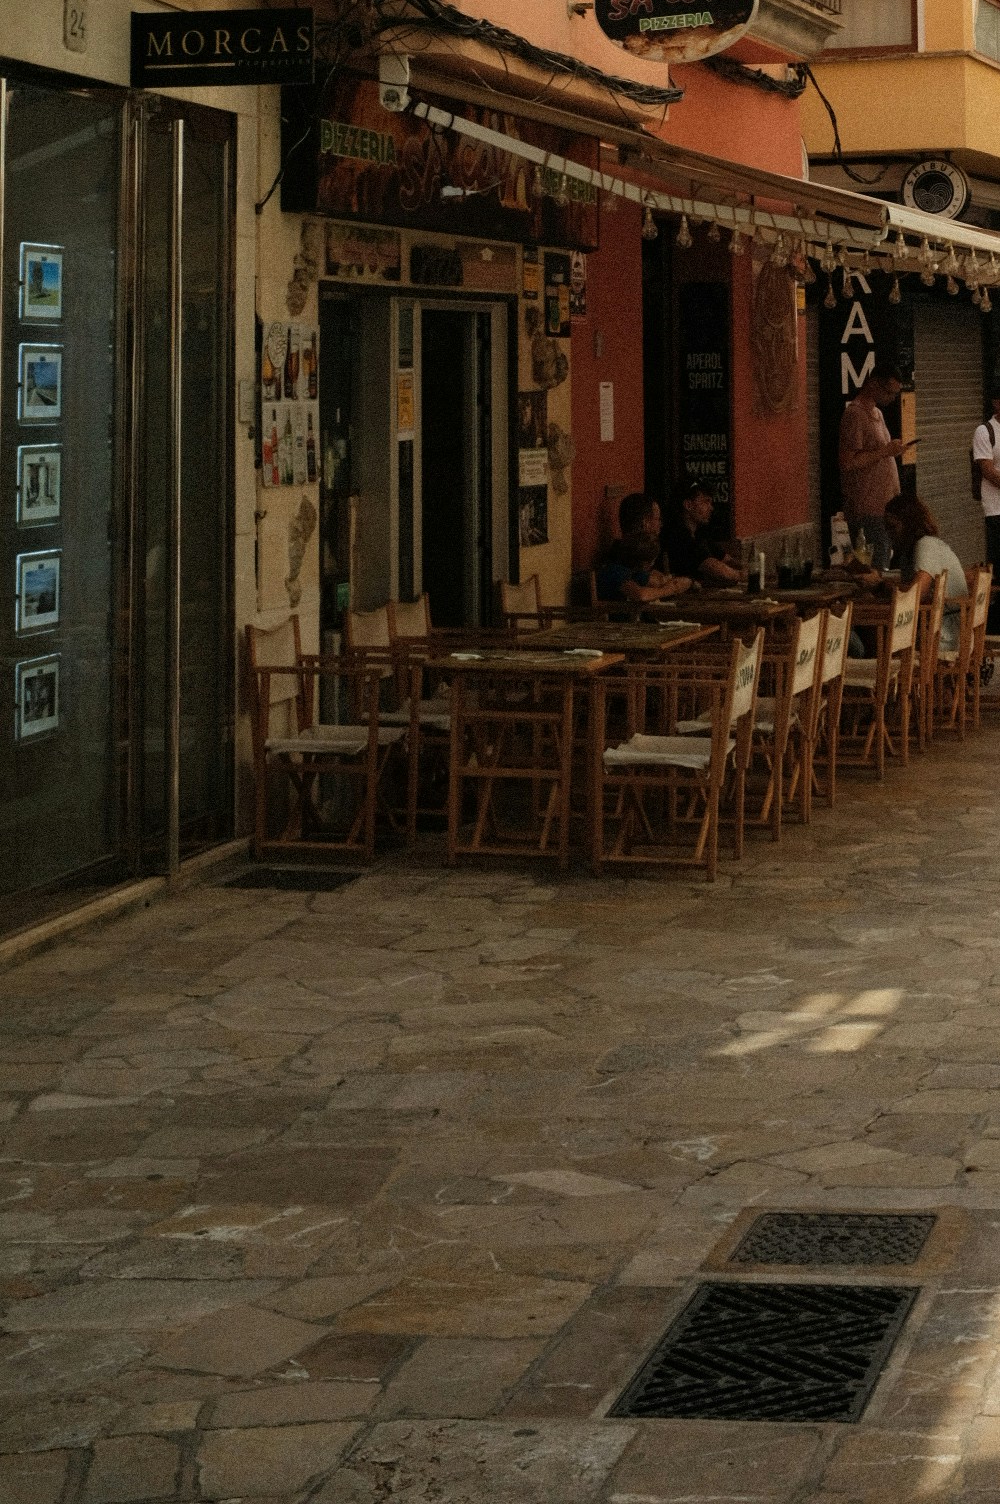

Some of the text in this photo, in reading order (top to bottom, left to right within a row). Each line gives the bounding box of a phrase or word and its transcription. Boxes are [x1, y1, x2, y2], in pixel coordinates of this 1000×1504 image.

[69, 9, 86, 39] 24
[639, 11, 714, 32] PIZZERIA
[146, 26, 311, 57] MORCAS
[320, 119, 398, 168] PIZZERIA
[686, 352, 723, 370] APEROL
[688, 372, 723, 390] SPRITZ
[683, 433, 727, 451] SANGRIA
[686, 460, 726, 475] WINE
